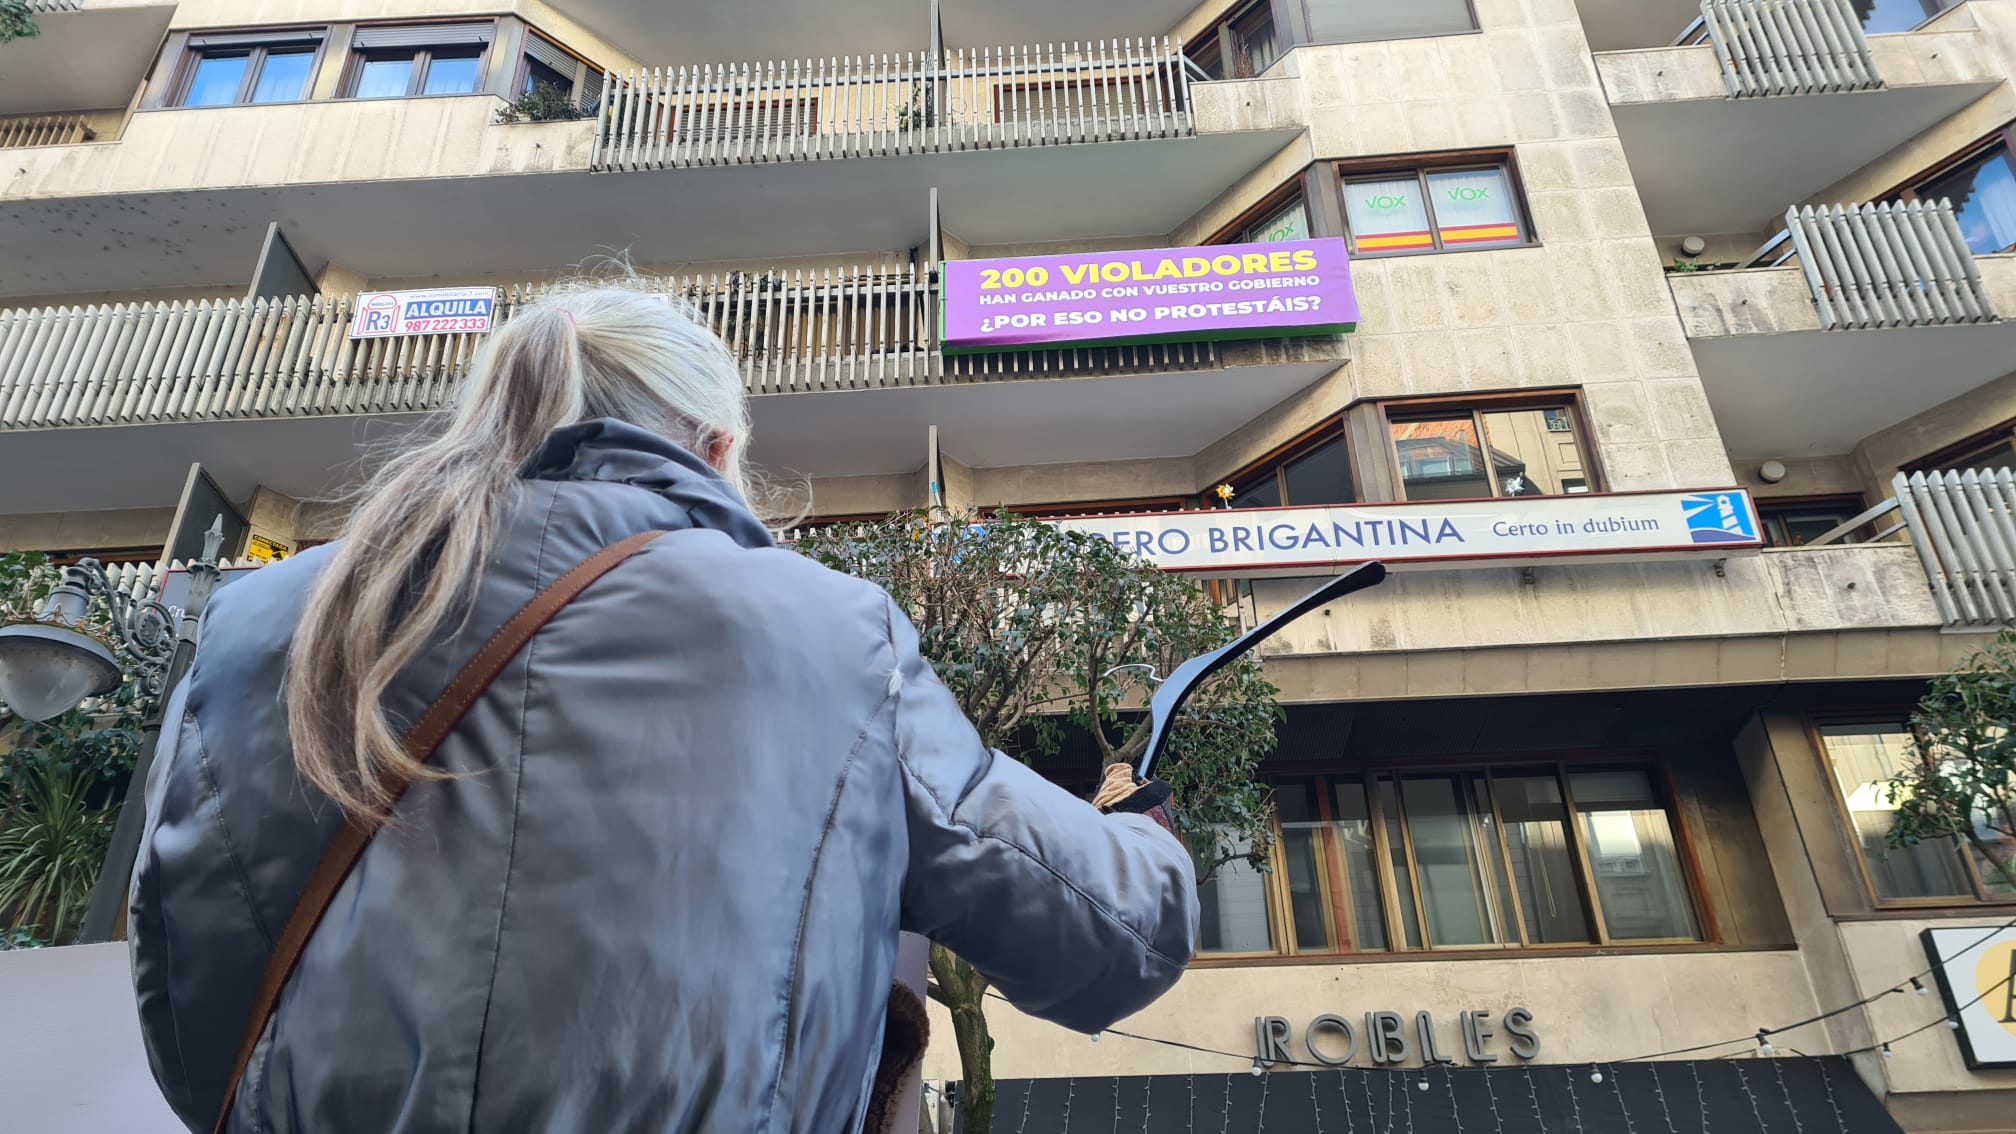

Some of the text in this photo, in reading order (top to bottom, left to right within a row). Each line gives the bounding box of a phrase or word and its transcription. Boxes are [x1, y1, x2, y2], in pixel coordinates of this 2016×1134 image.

[1365, 196, 1406, 209] VOX
[1448, 187, 1488, 201] VOX
[979, 249, 1318, 290] 200 VIOLADORES
[979, 275, 1320, 305] HAN GANADO CON VUESTRO GOBIERNO
[365, 311, 391, 331] R3
[406, 301, 488, 318] ALQUILA
[980, 296, 1321, 332] ¿POR ESO NO PROTESTÁIS?
[405, 318, 486, 332] 987 222 333
[1208, 517, 1466, 553] BRIGANTINA
[1493, 521, 1549, 537] Certo
[1555, 520, 1575, 534] in
[1583, 517, 1660, 534] dubium
[1255, 1007, 1541, 1068] ROBLES
